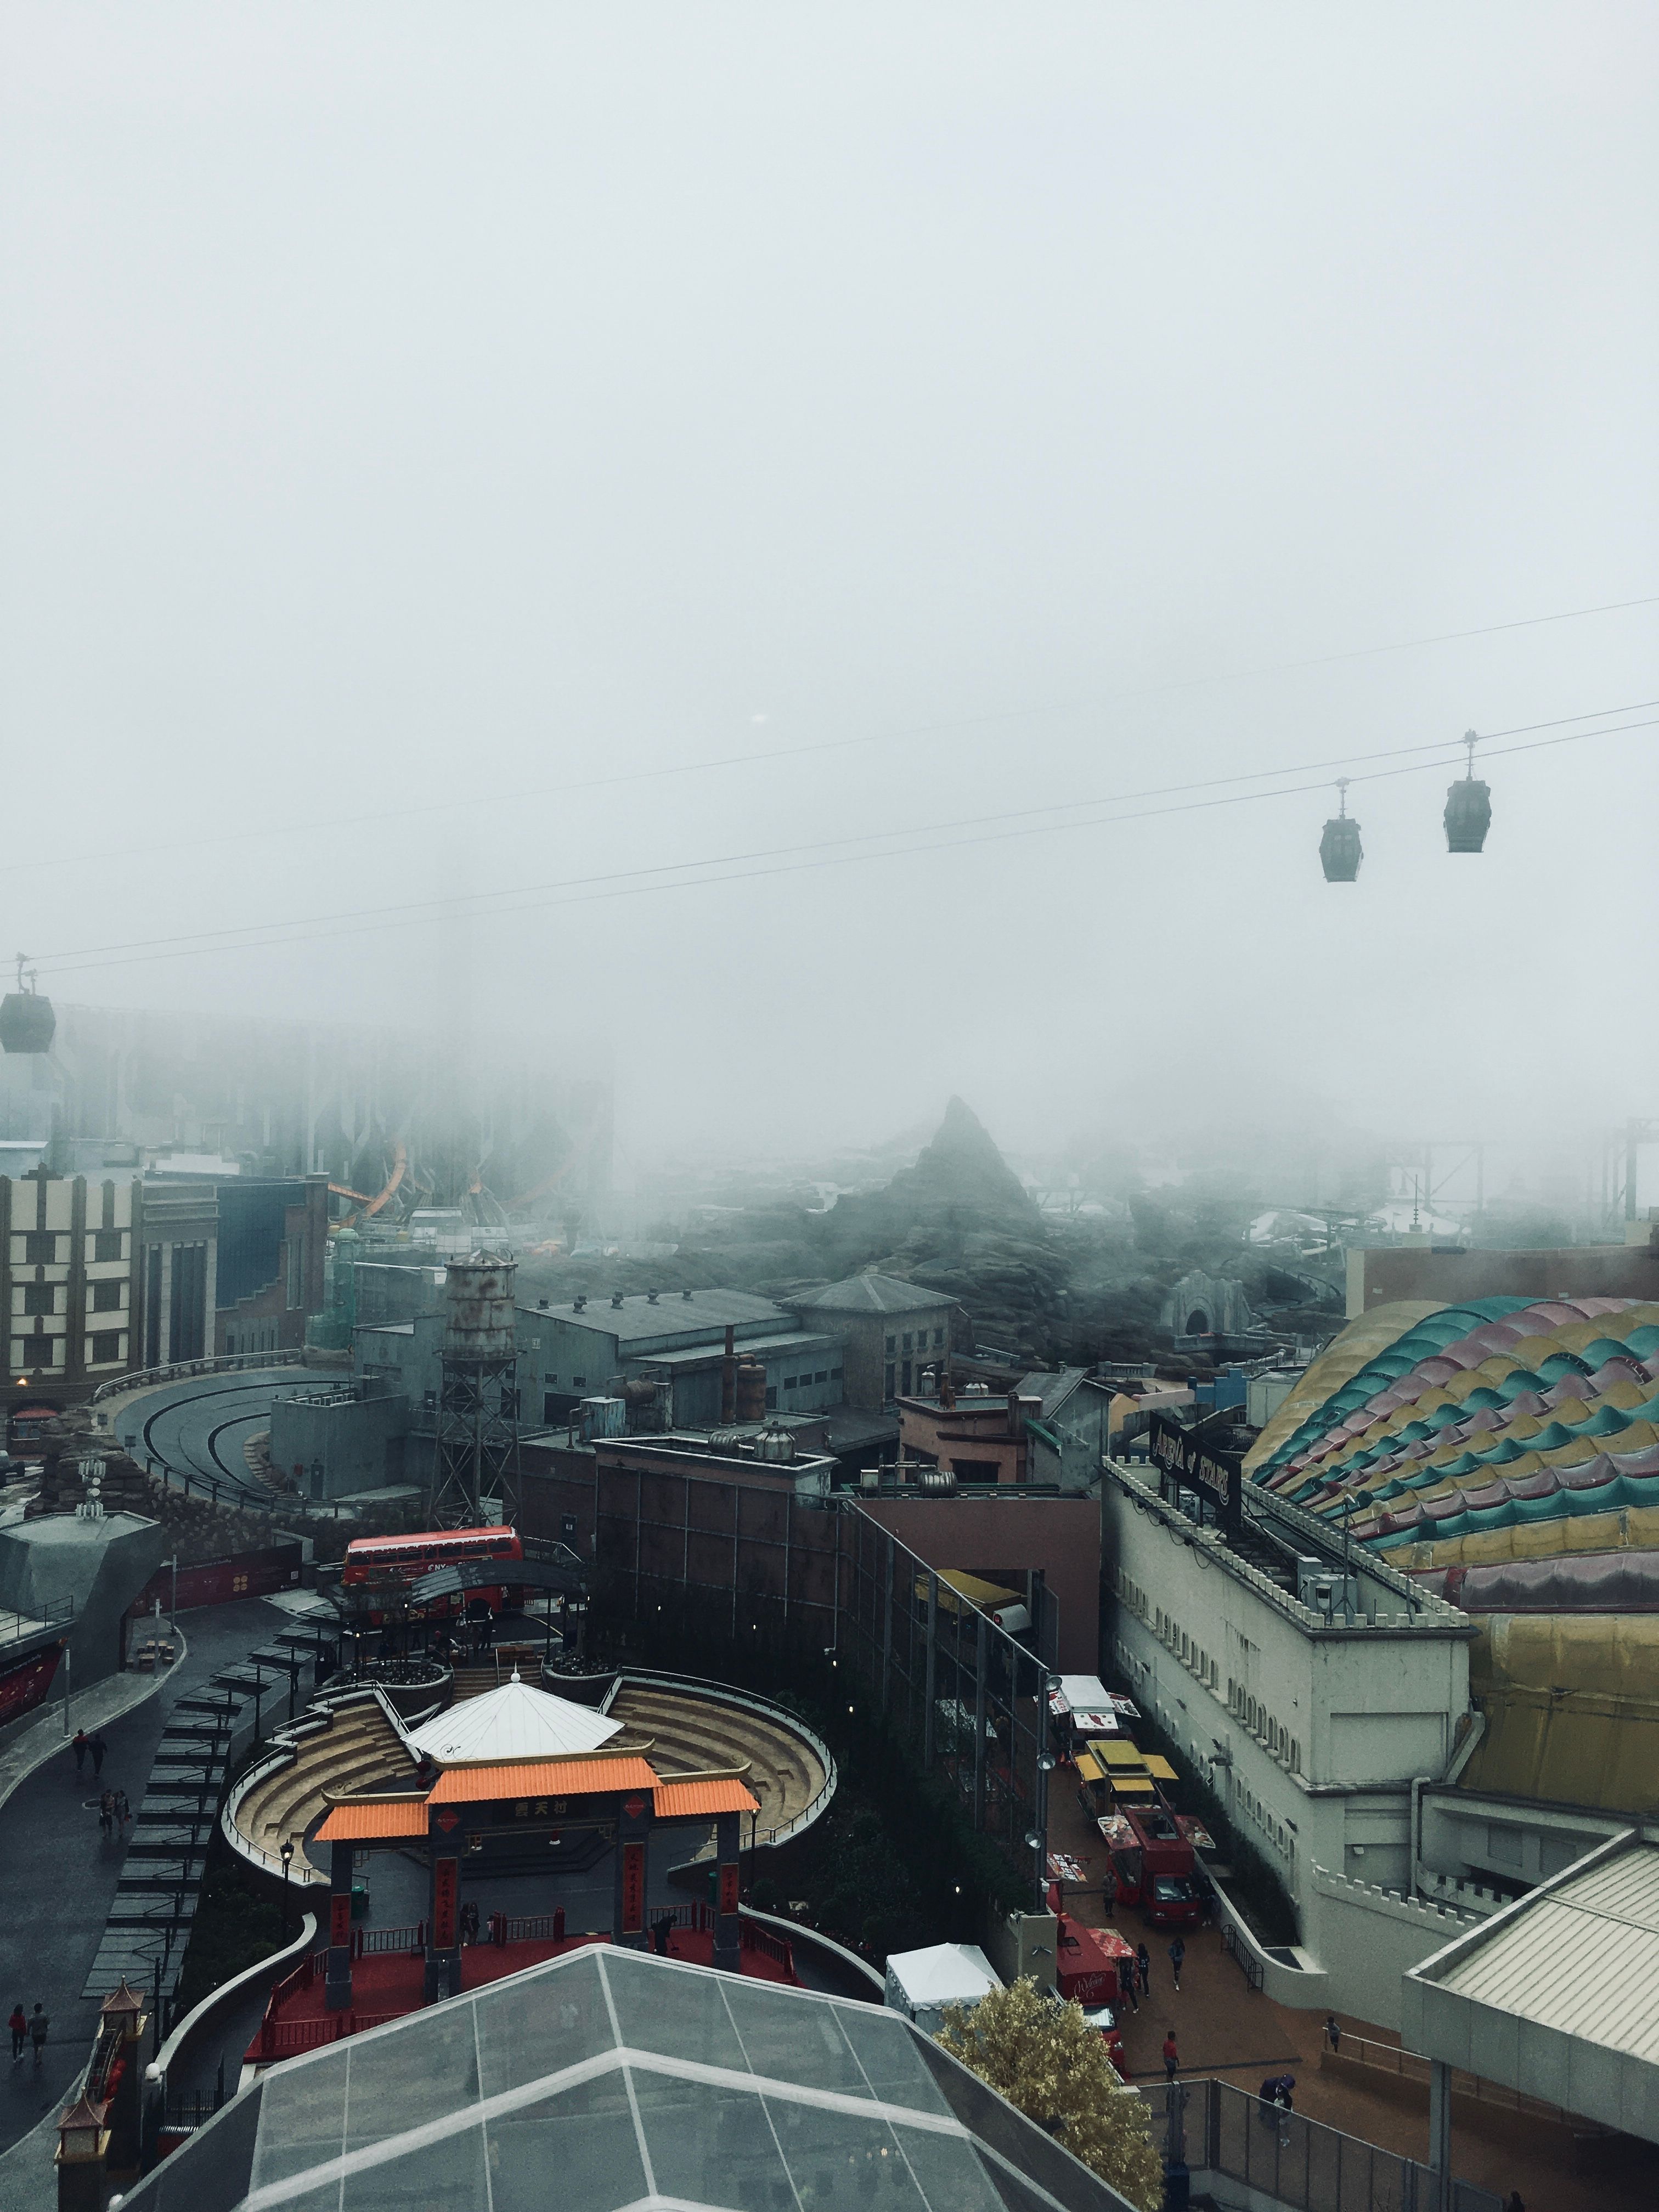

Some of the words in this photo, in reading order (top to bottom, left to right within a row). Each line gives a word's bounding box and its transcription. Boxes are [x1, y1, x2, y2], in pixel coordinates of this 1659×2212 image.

[1153, 1424, 1184, 1470] ARENA
[1187, 1452, 1197, 1474] of
[1199, 1455, 1229, 1505] STARS
[1074, 1973, 1105, 1997] Welcome
